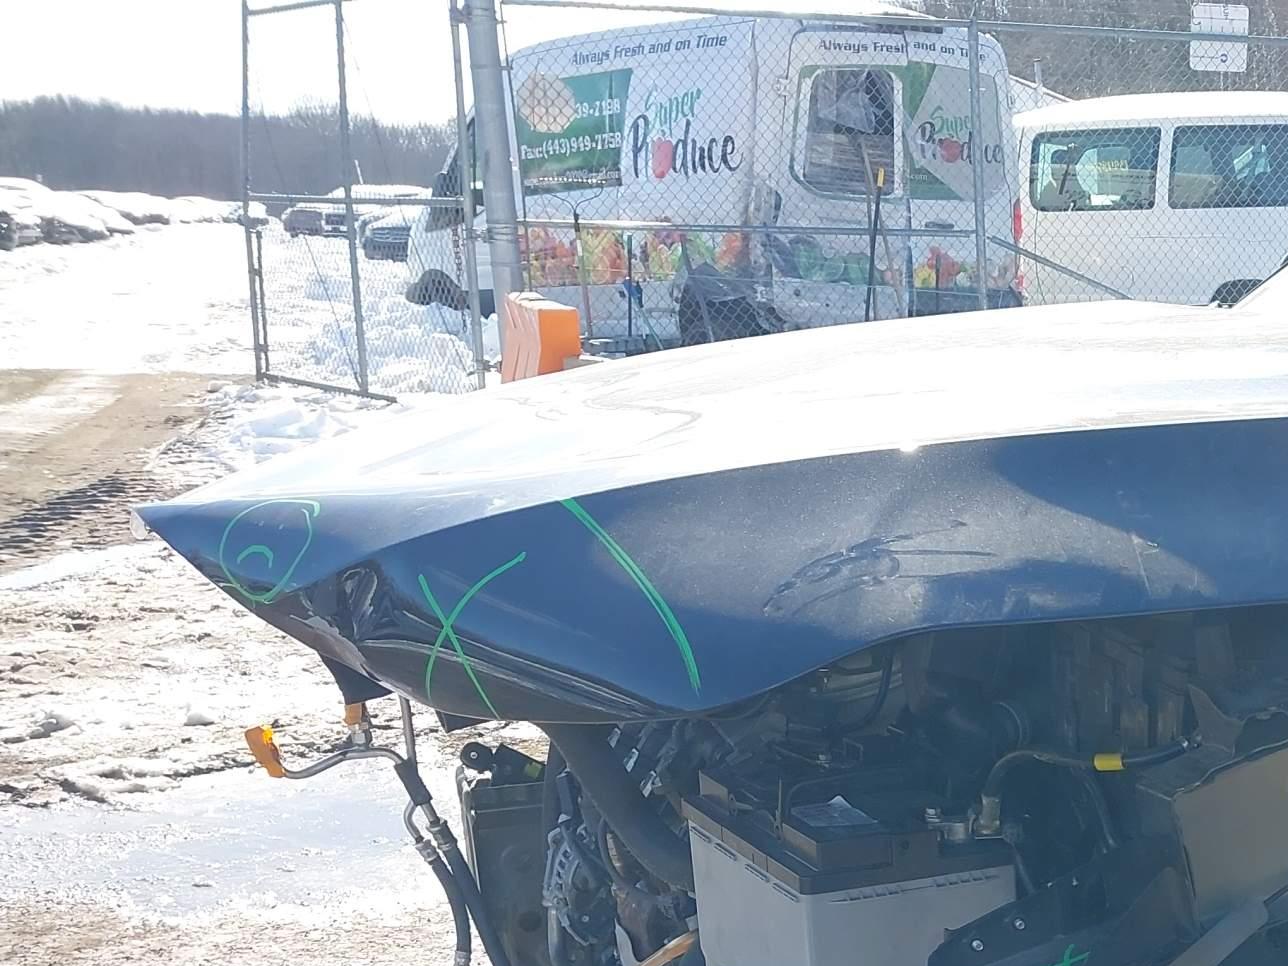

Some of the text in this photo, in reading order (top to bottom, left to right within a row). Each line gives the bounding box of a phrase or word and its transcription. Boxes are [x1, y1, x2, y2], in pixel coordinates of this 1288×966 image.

[571, 34, 728, 66] Always Fresh and on Time
[818, 39, 869, 54] Always
[913, 40, 937, 52] and
[940, 44, 958, 55] on
[960, 48, 987, 61] Tie
[645, 83, 702, 138] Super
[930, 105, 972, 138] Supe
[913, 120, 1003, 166] Prodce
